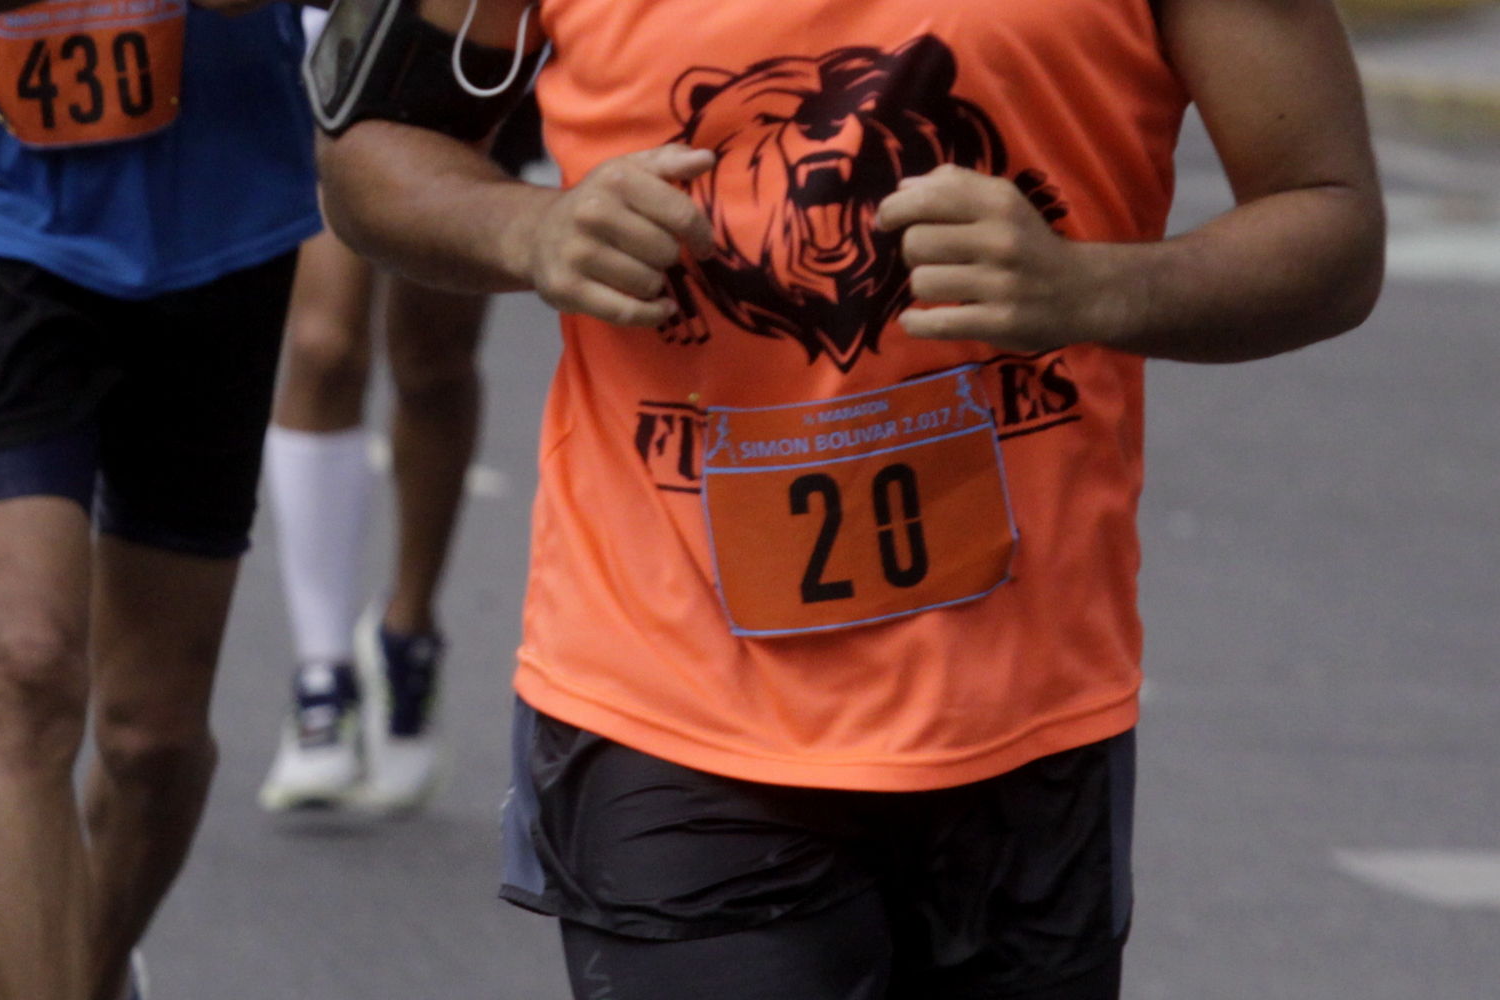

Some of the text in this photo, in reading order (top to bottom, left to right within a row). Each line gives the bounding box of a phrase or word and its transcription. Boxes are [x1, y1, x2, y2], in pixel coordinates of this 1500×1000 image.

[17, 31, 154, 130] 430
[739, 407, 952, 460] SIMON BOLIVAR 2.017
[789, 462, 930, 605] 20
